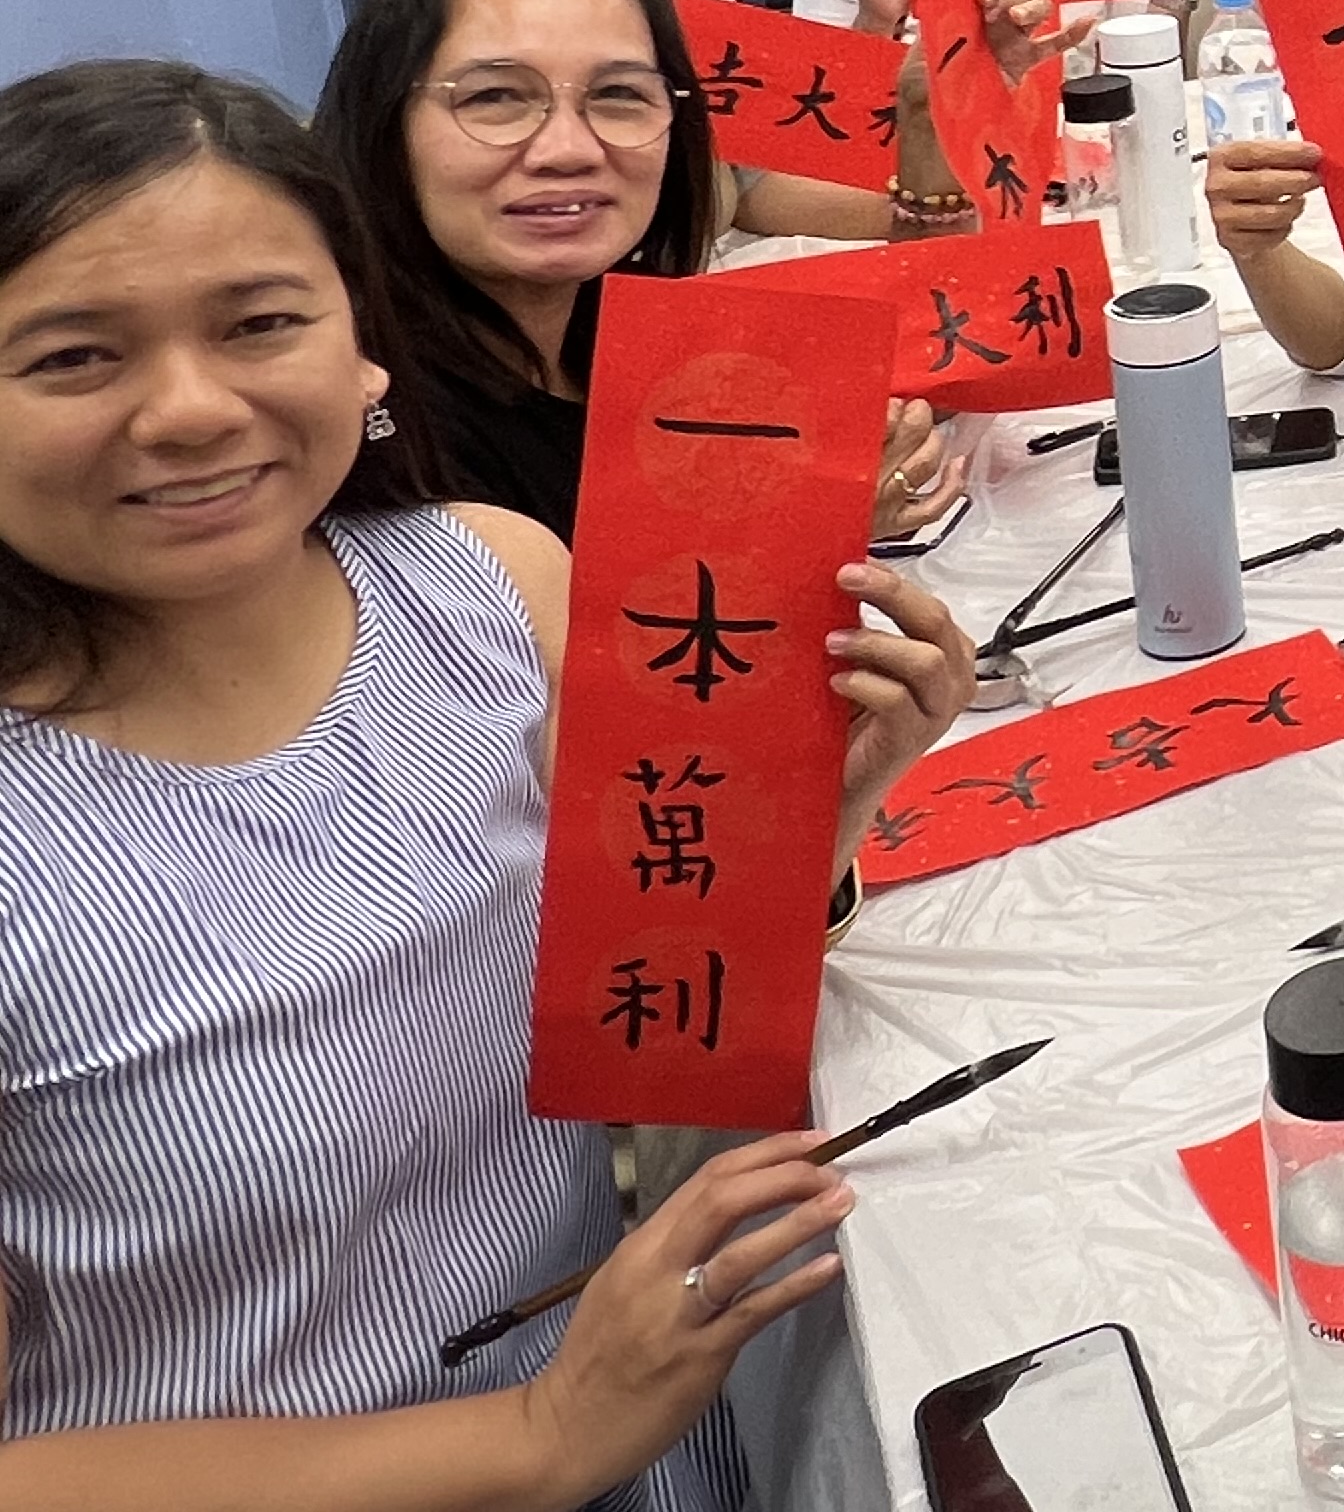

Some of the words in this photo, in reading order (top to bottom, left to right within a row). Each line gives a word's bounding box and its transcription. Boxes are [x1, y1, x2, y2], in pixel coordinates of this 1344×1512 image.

[930, 266, 1082, 373] 大利
[597, 416, 800, 1057] 一本萬利
